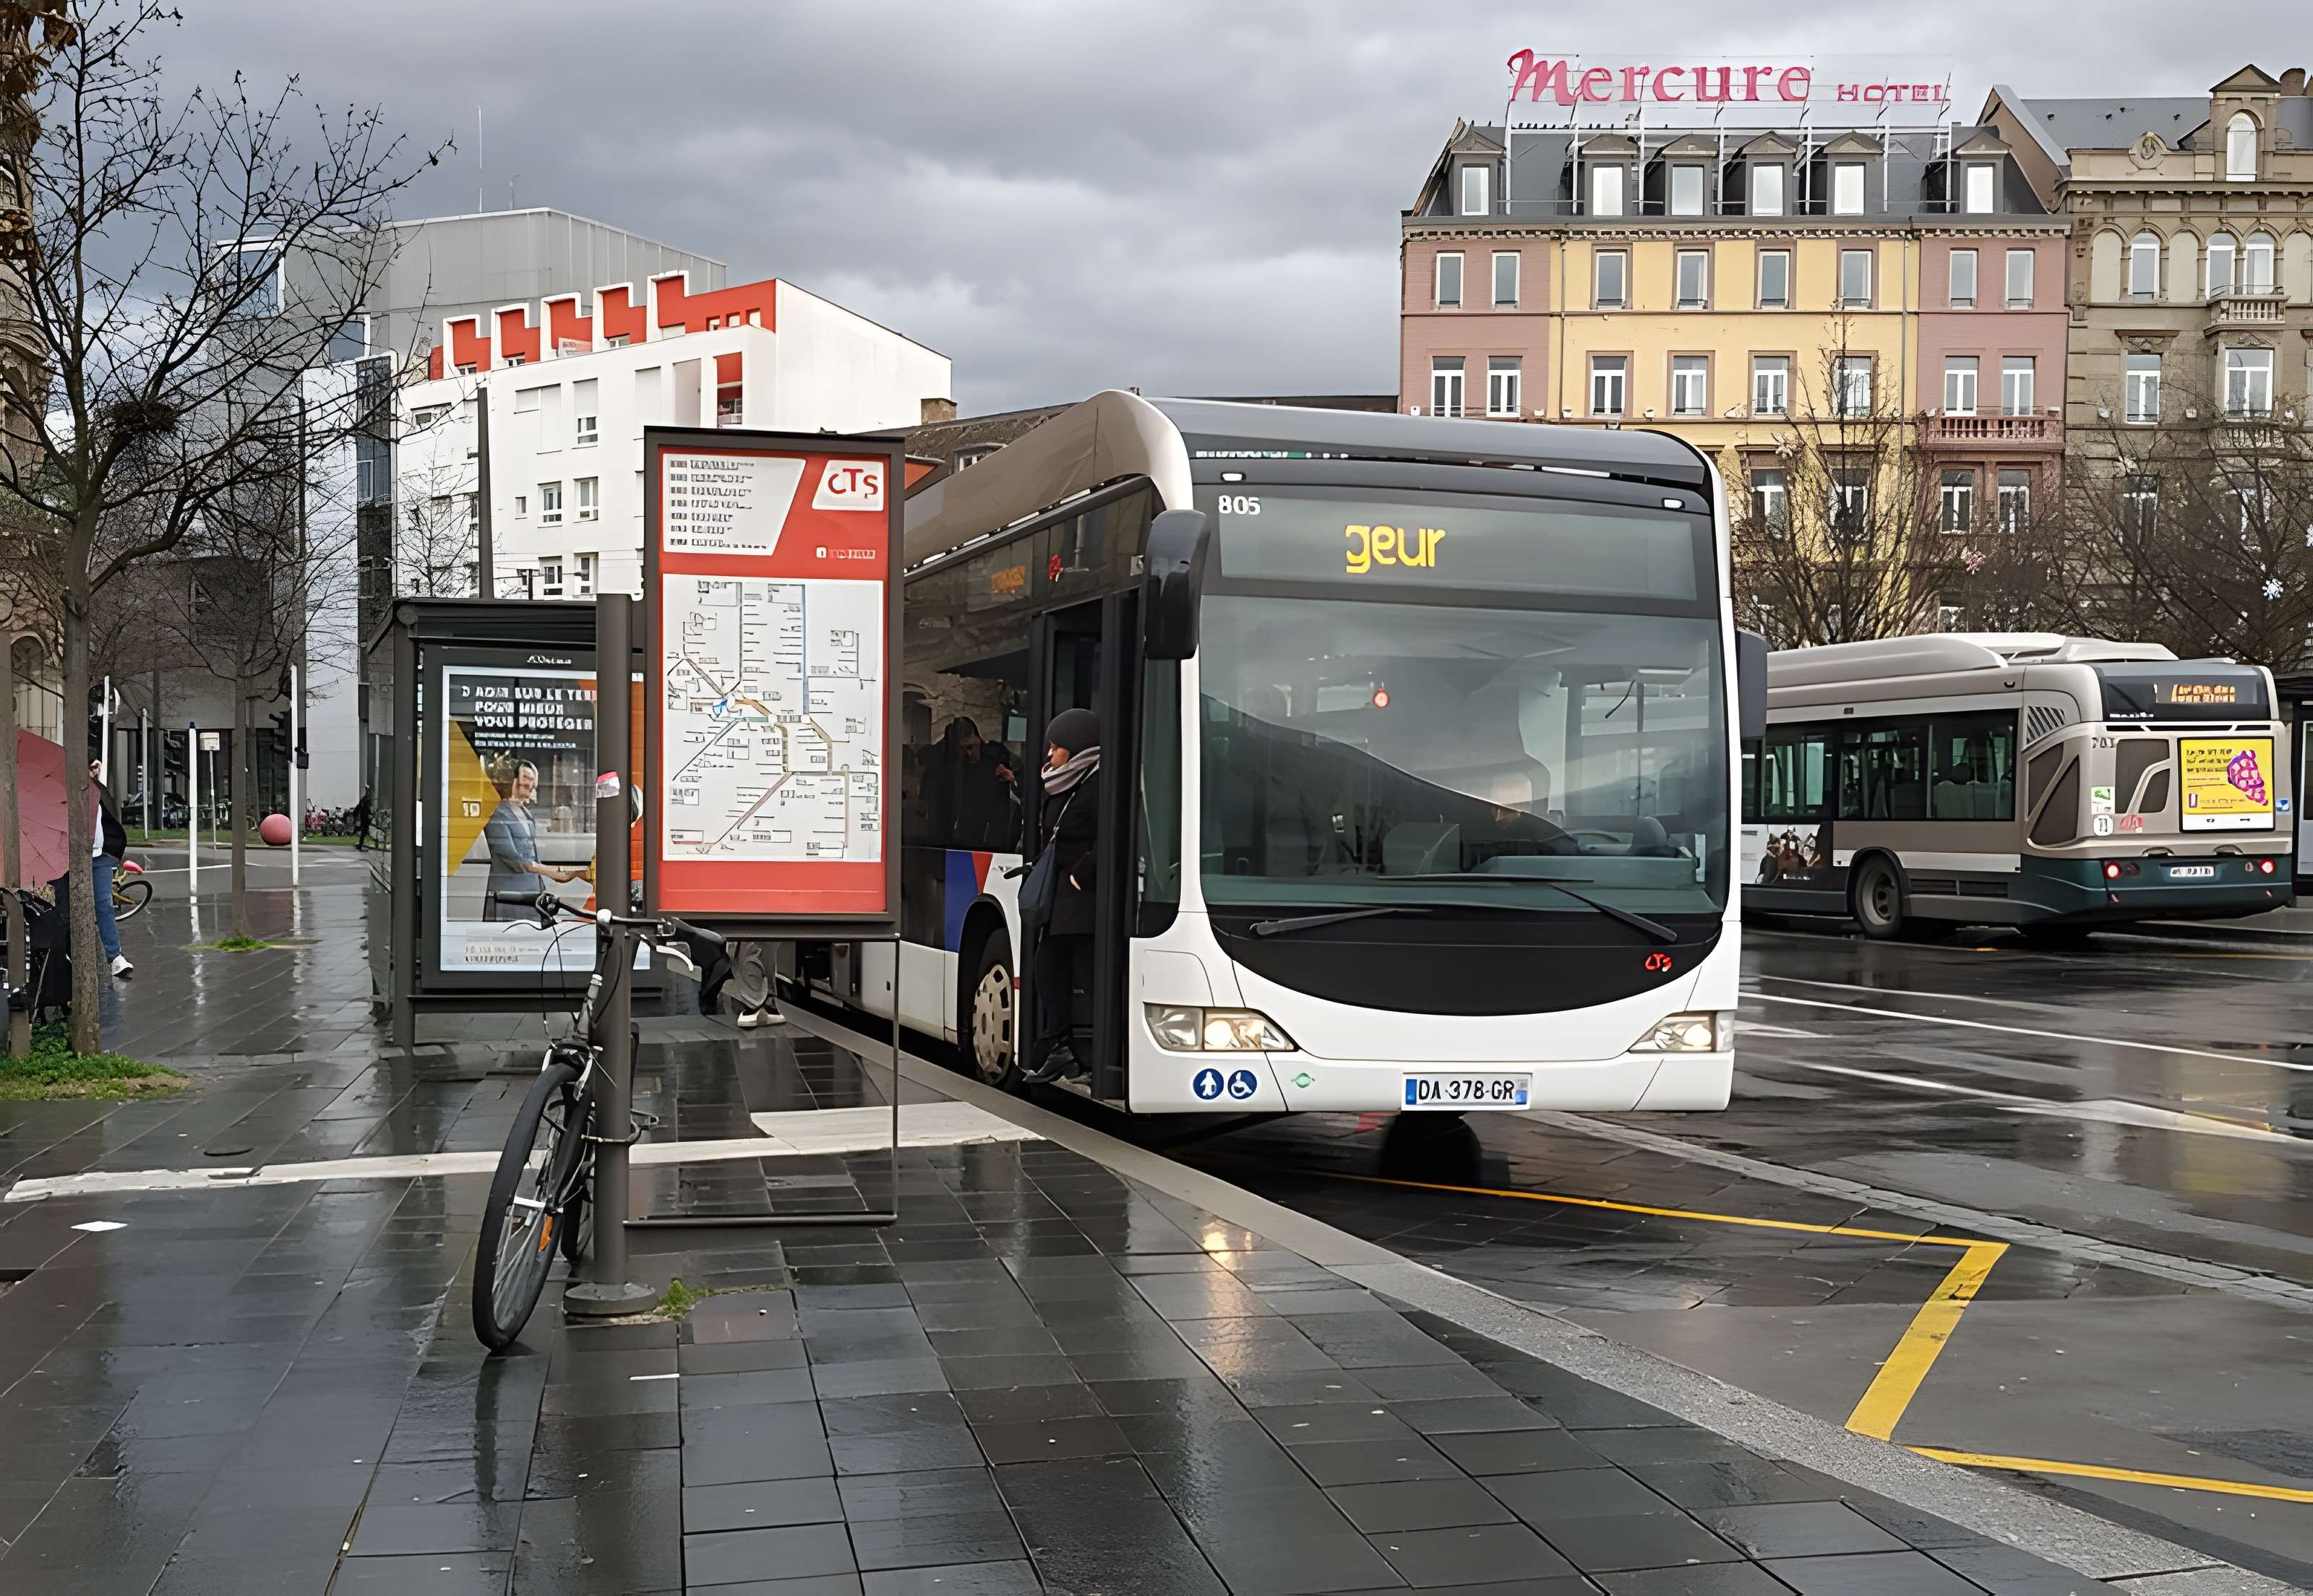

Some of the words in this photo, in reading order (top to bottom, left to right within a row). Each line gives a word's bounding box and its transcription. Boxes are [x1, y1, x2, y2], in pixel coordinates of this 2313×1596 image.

[1507, 48, 1811, 106] Mercure
[1837, 85, 1951, 102] HOTEL
[828, 468, 879, 499] CTS
[1219, 494, 1261, 515] 805
